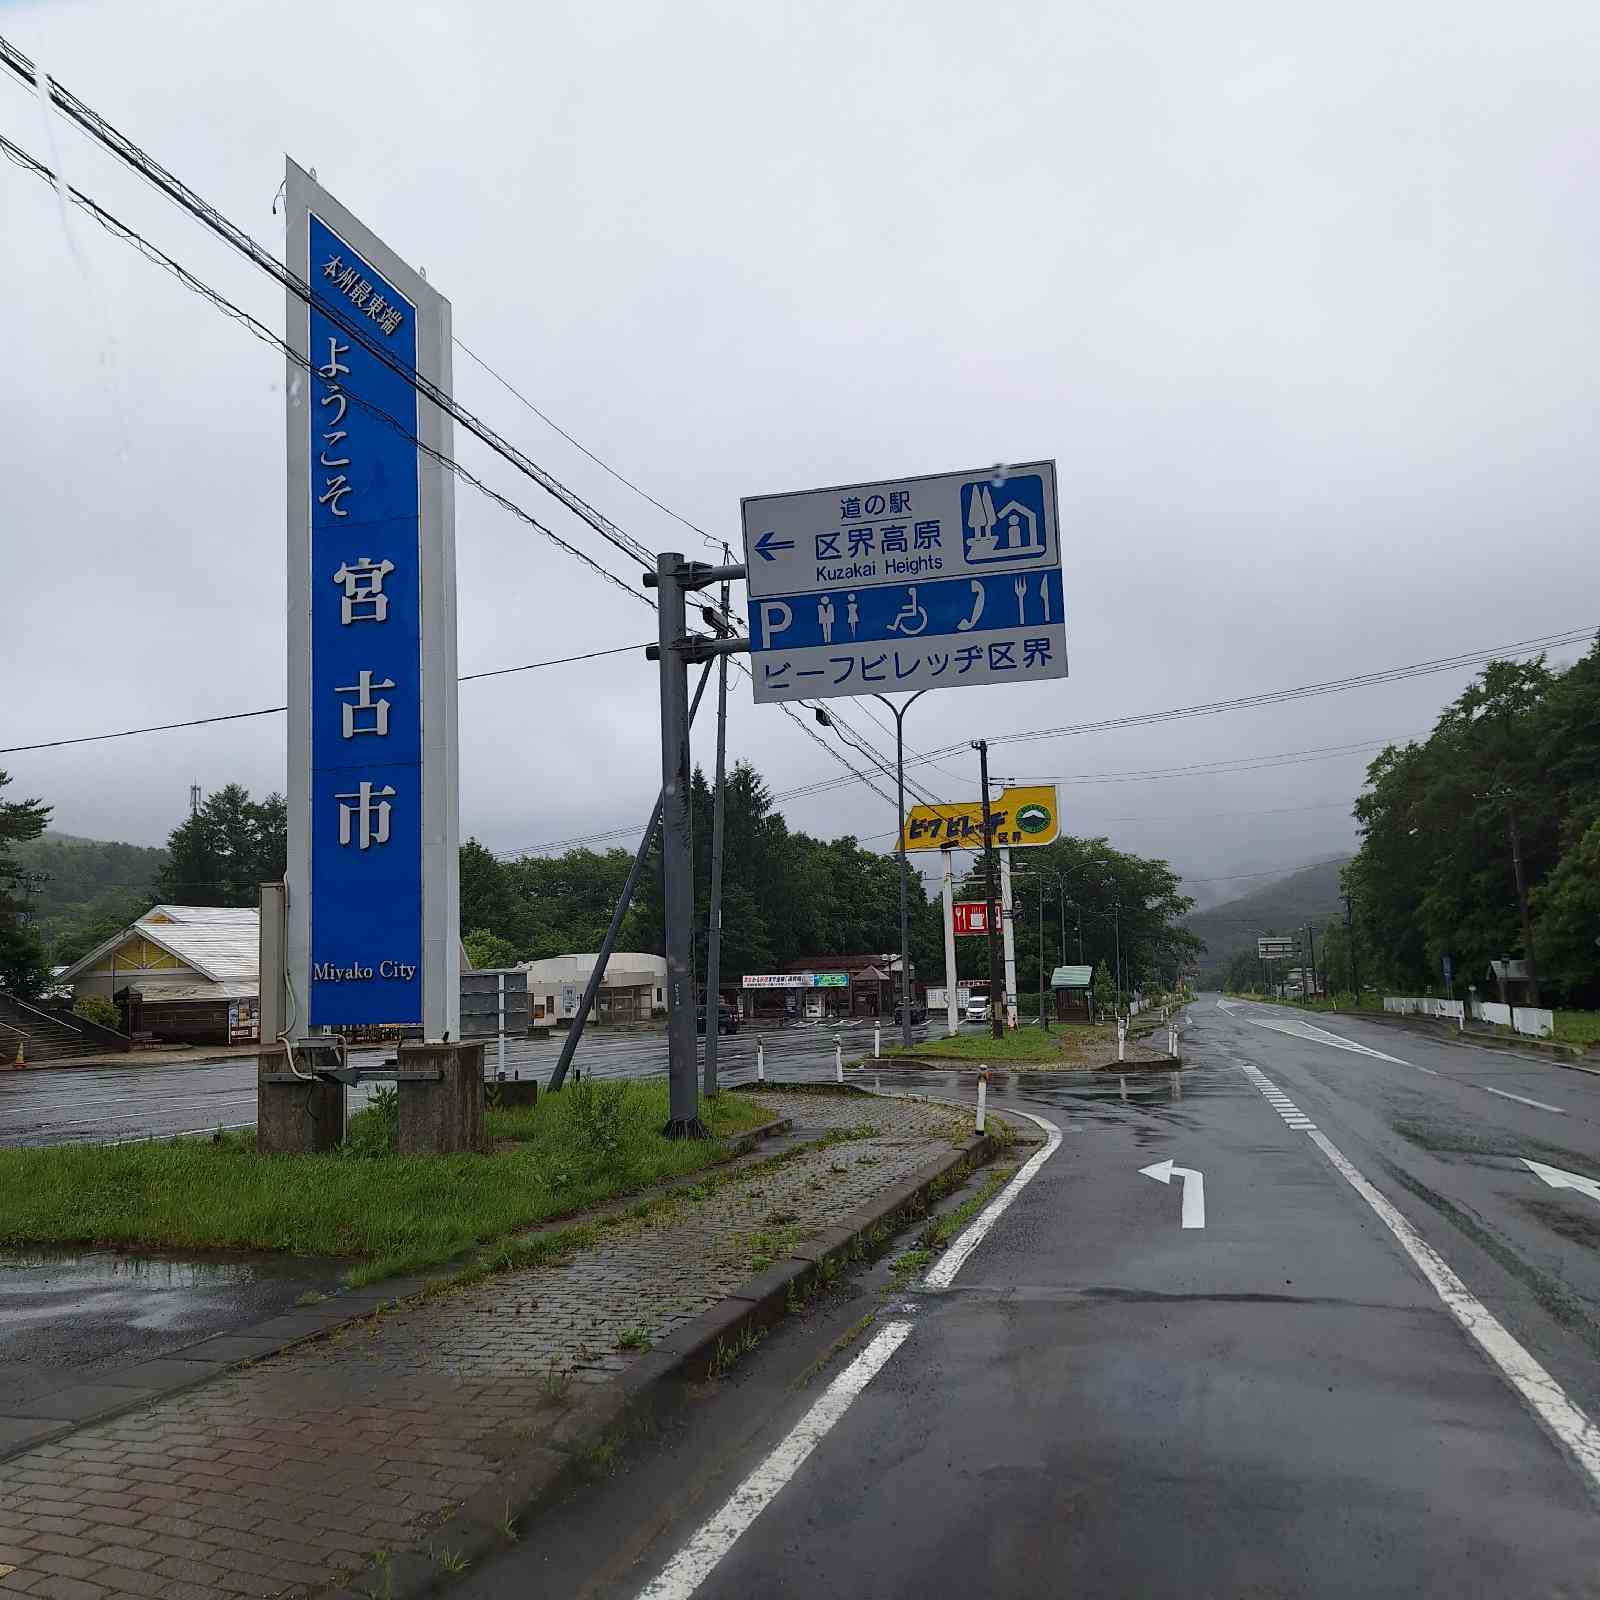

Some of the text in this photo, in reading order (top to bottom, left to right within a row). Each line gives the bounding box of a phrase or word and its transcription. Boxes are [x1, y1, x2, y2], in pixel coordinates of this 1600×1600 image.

[320, 254, 404, 335] 本州最東端
[319, 337, 351, 516] ようこそ
[840, 490, 912, 520] 道の駅
[815, 519, 943, 561] 区界高原
[816, 555, 943, 582] Kuzakai Heights
[760, 601, 793, 649] P
[765, 637, 1053, 688] ビーフビレッヂ区界
[334, 557, 396, 850] 宮古市
[313, 960, 417, 983] Miyako City
